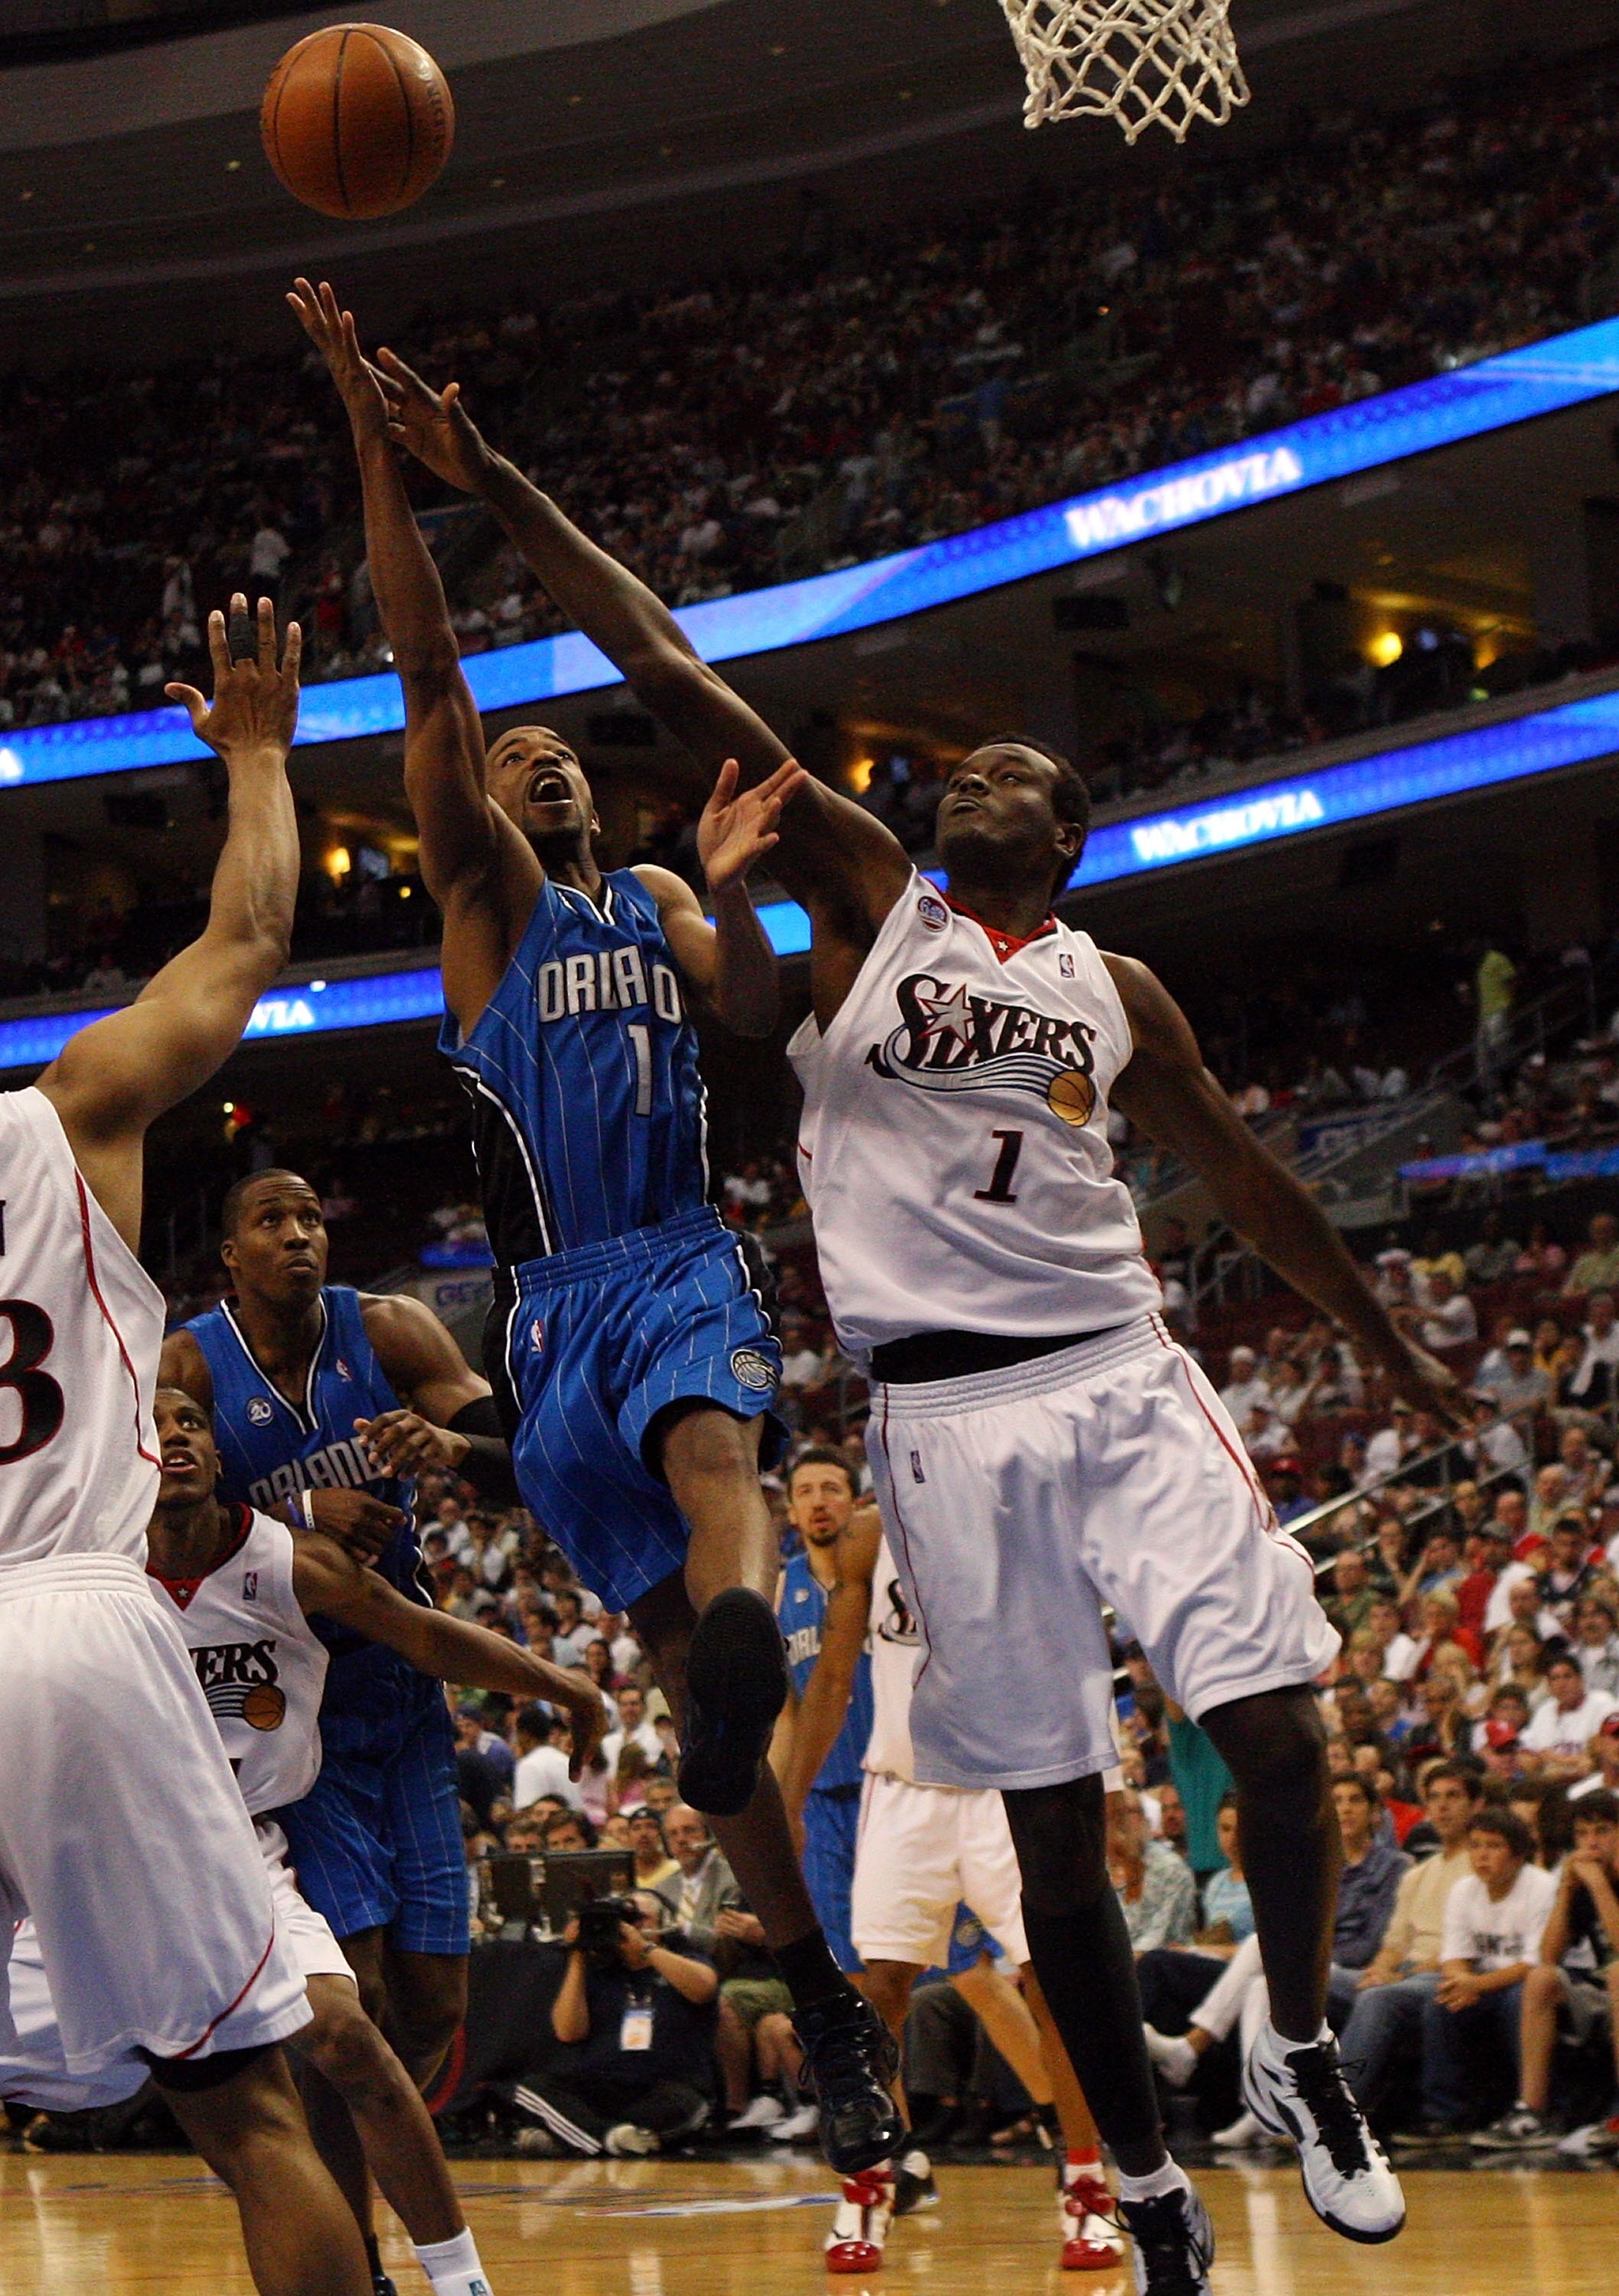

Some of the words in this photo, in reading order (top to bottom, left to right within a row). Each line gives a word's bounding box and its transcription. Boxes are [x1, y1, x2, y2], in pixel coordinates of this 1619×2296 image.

[1064, 446, 1302, 546] WACHOVIA
[1132, 790, 1325, 861] WACHOVIA
[627, 1024, 652, 1117] 1
[973, 1130, 1024, 1203] 1
[189, 1639, 278, 1688] ERS
